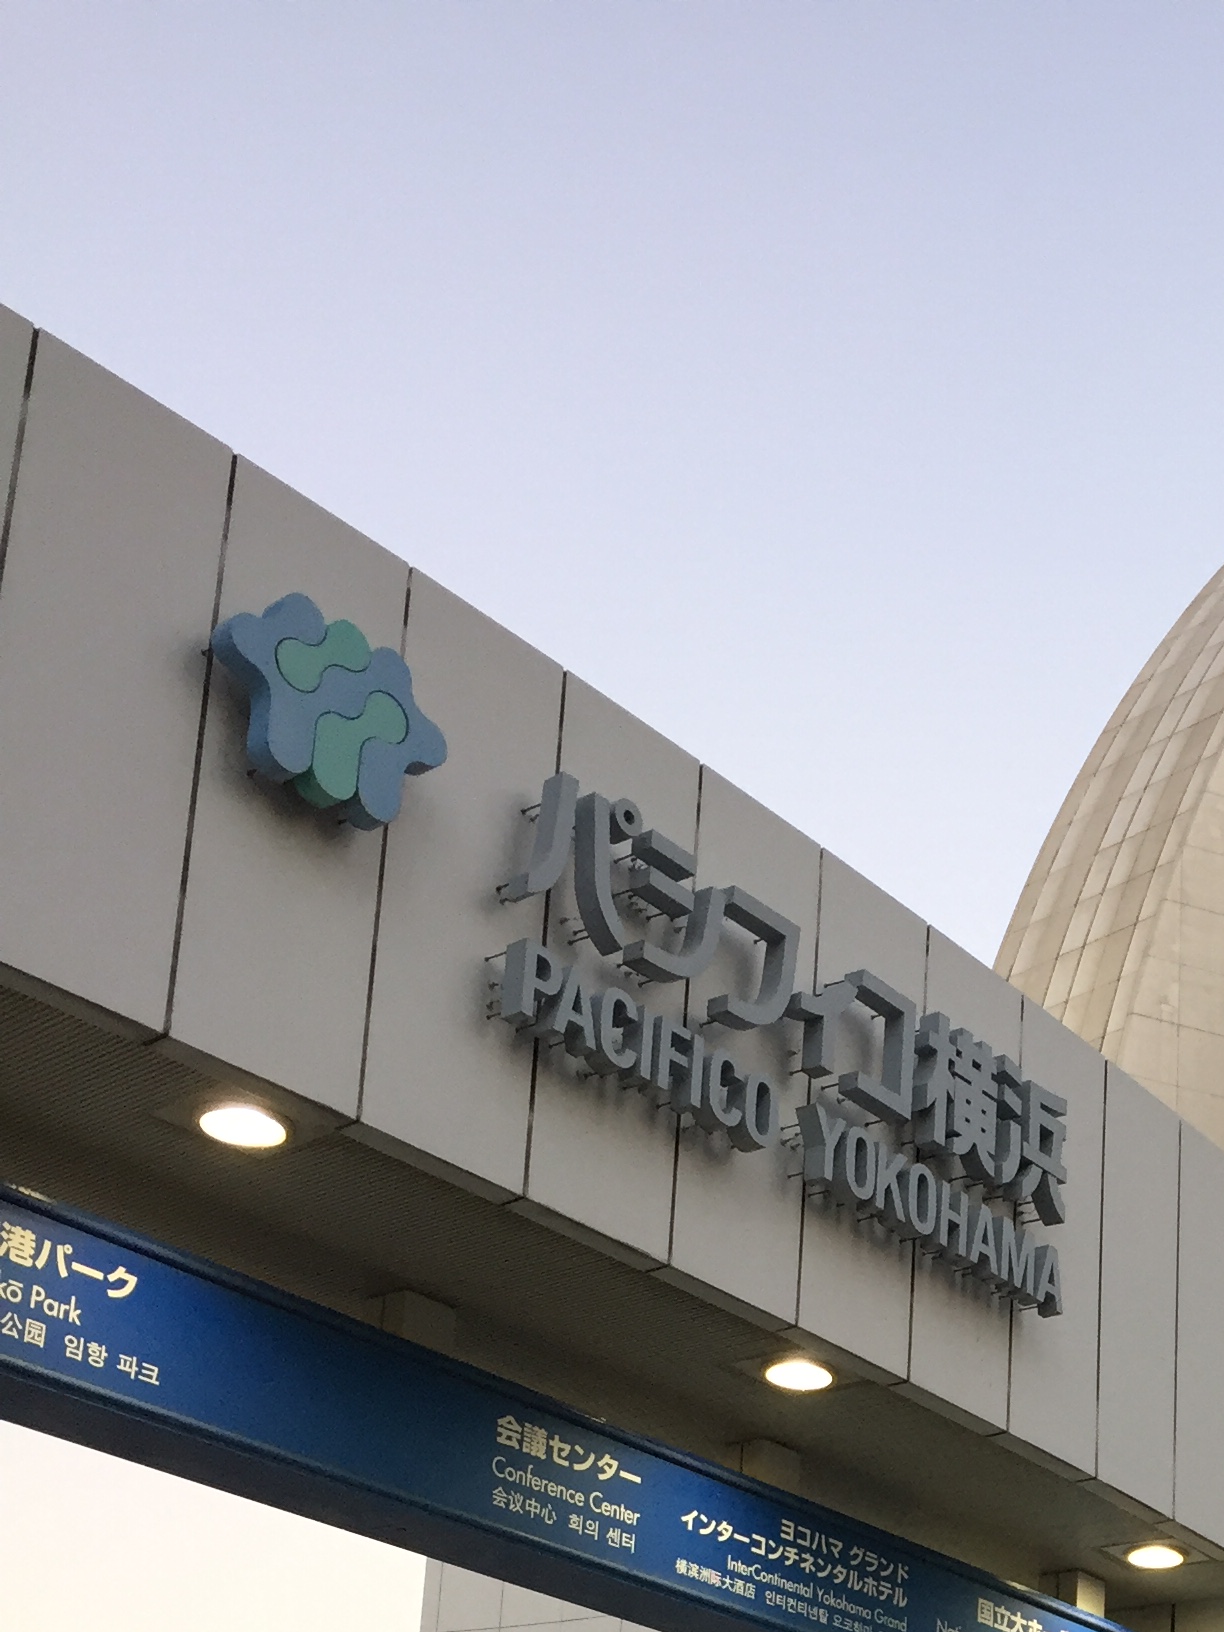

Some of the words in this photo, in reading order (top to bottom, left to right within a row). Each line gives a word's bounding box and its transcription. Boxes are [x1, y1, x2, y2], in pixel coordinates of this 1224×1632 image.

[501, 771, 1067, 1226] パシフィコ横浜
[501, 937, 780, 1153] PACIFICO
[797, 1101, 1063, 1317] YOKOHAMA
[30, 1284, 82, 1326] Park
[64, 1334, 108, 1368] 임항
[117, 1353, 160, 1386] 파크
[496, 1414, 642, 1485] 会議センター
[491, 1486, 557, 1525] 会议中心
[492, 1456, 585, 1507] Conference
[589, 1491, 641, 1526] Center
[568, 1512, 600, 1541] 회의
[606, 1527, 636, 1554] 센터
[681, 1509, 908, 1608] インターコンチネンタルホテル
[780, 1518, 843, 1557] ヨコハマ
[848, 1545, 909, 1583] グランド
[727, 1555, 814, 1599] InterContinental
[816, 1585, 872, 1620] Yokohama
[874, 1608, 907, 1632] Grand
